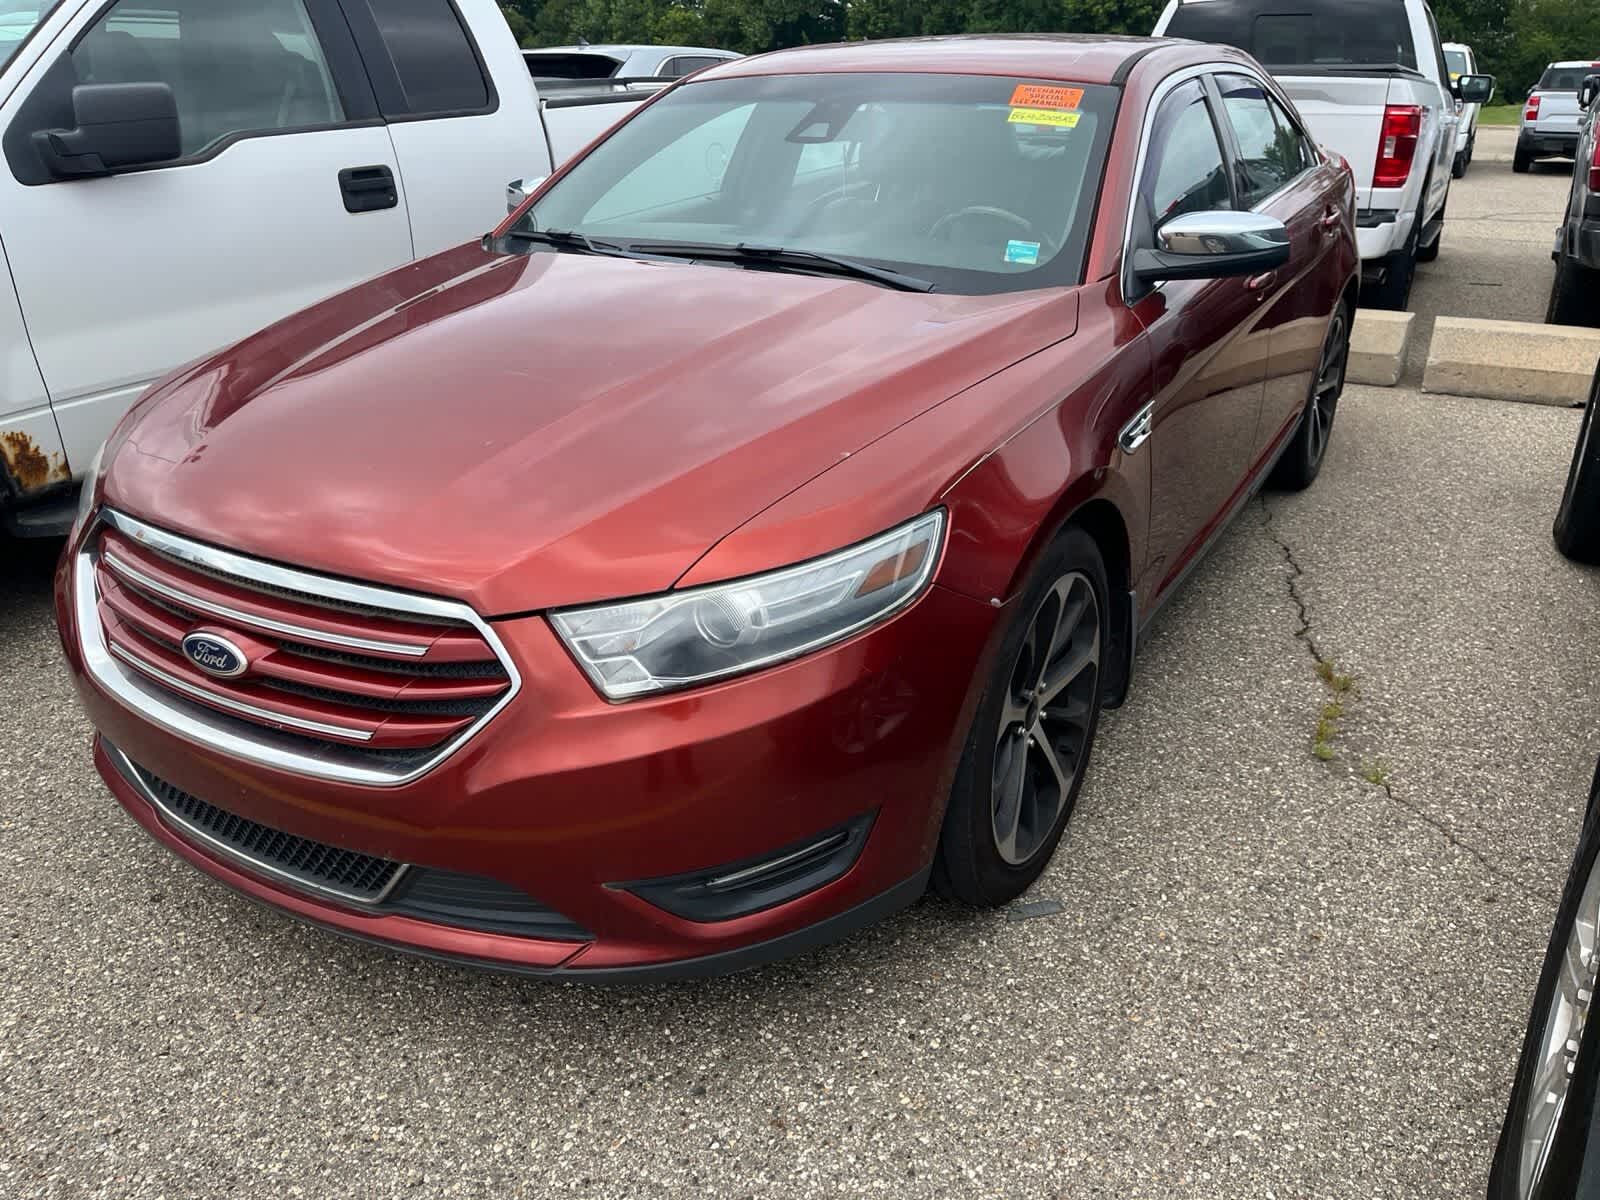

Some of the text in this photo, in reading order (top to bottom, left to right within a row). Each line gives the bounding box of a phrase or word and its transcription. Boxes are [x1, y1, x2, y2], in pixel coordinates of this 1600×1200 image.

[1029, 93, 1065, 101] SPECIAL
[1031, 99, 1076, 108] MANAGER
[193, 641, 228, 668] Ford
